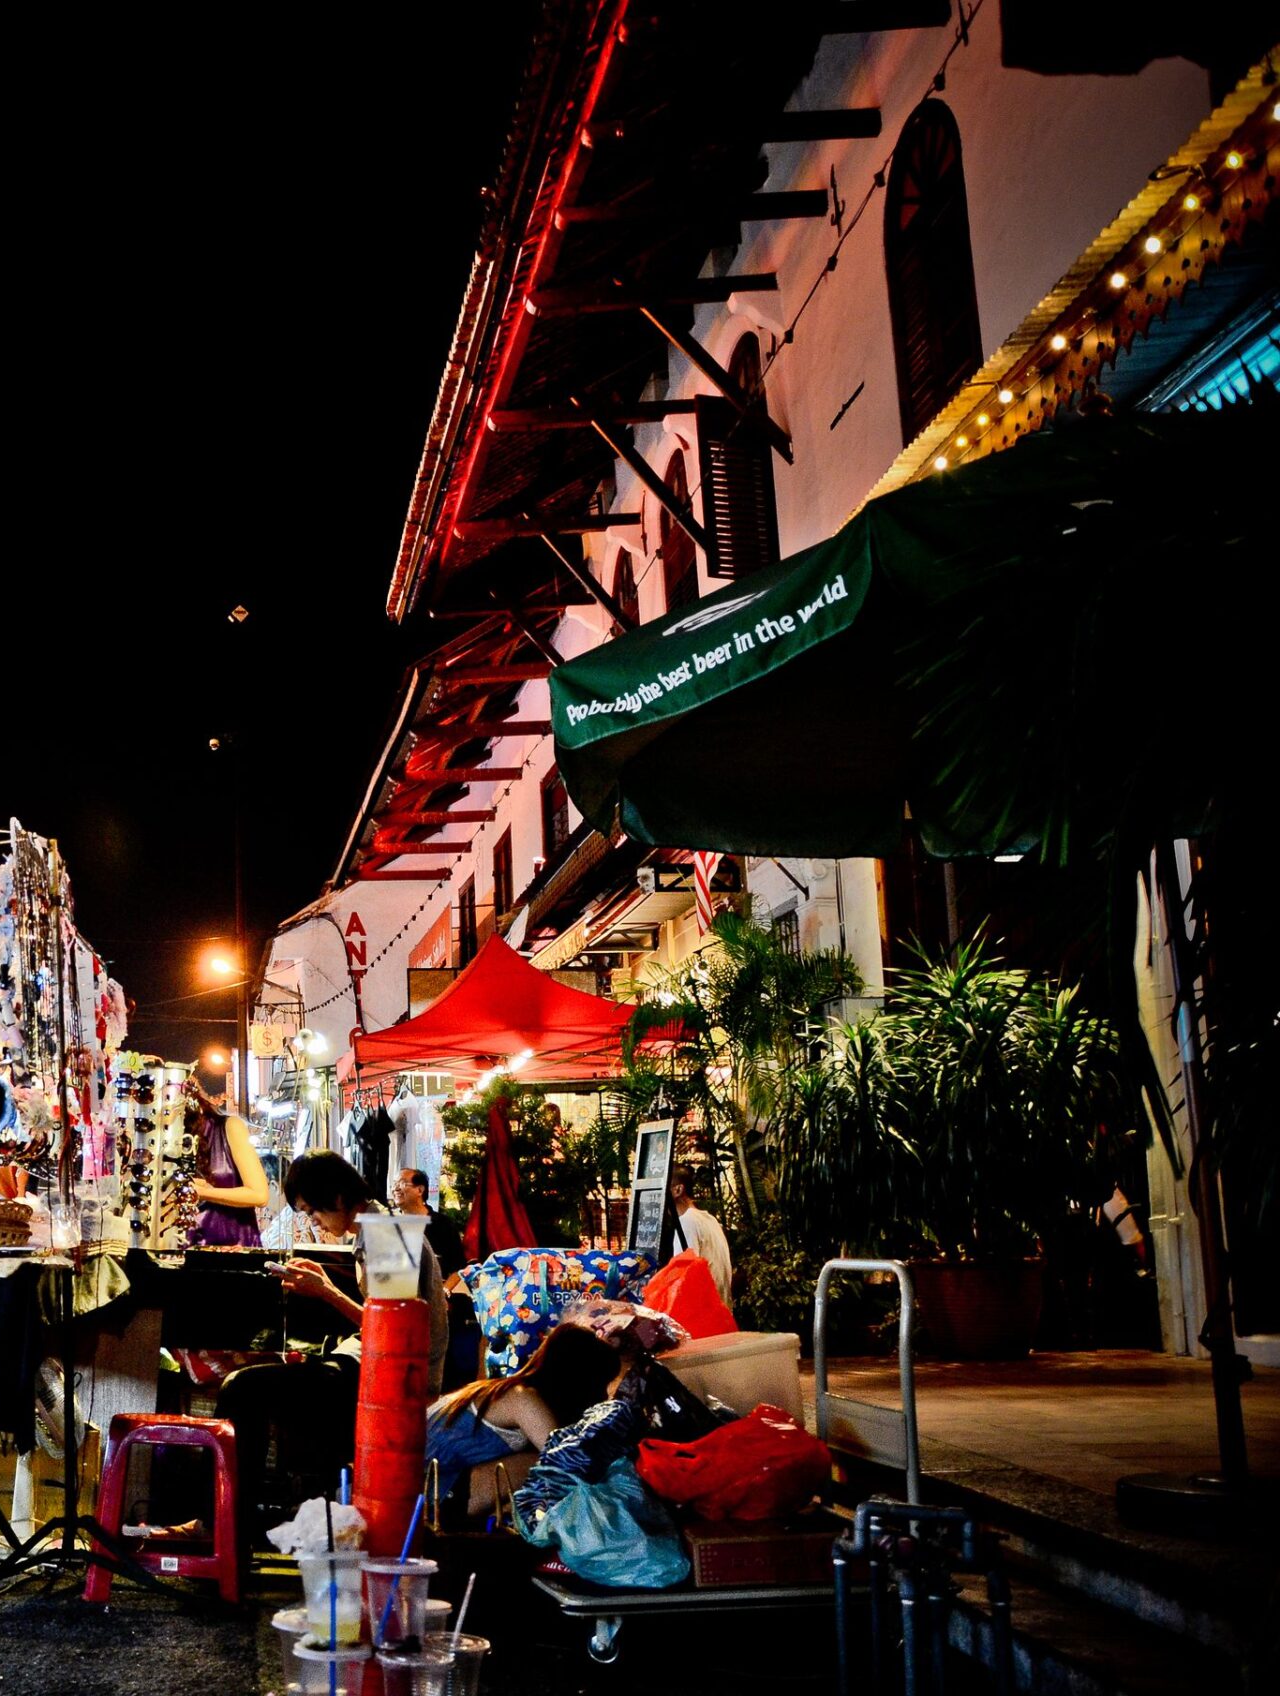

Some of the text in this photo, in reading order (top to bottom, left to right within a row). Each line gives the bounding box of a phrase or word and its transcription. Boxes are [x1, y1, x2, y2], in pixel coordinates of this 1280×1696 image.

[566, 692, 642, 727] Probably
[637, 682, 664, 705] the
[656, 660, 693, 692] best
[692, 641, 733, 675] beer
[732, 632, 756, 655] in
[754, 614, 797, 644] the
[533, 1290, 581, 1306] HPPY
